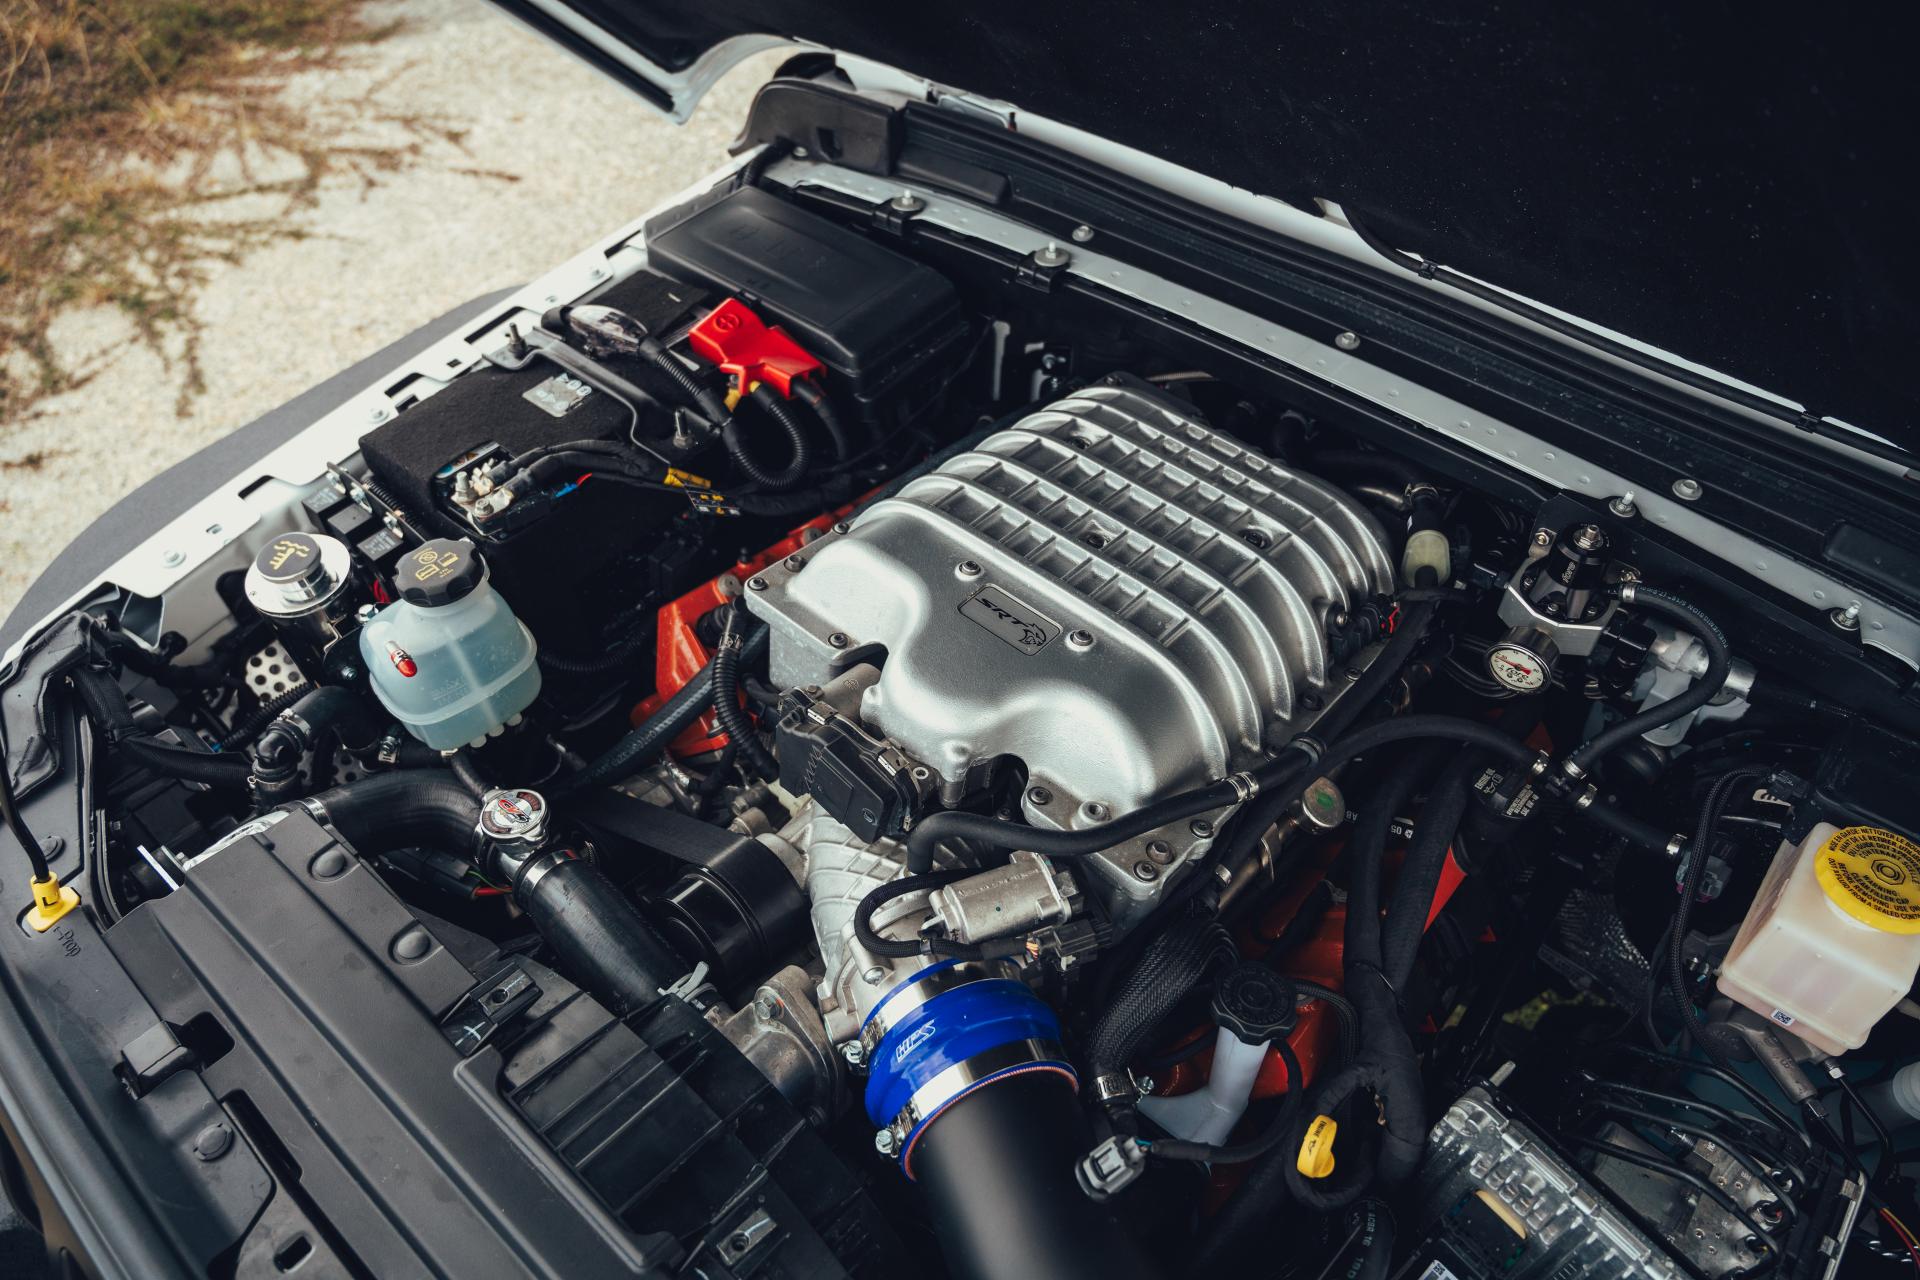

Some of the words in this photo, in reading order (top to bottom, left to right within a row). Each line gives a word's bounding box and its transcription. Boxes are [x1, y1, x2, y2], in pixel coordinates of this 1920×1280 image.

[974, 597, 1029, 628] SRT
[1848, 888, 1867, 904] FROM
[1873, 904, 1900, 918] SEALED
[895, 1019, 936, 1063] HPS
